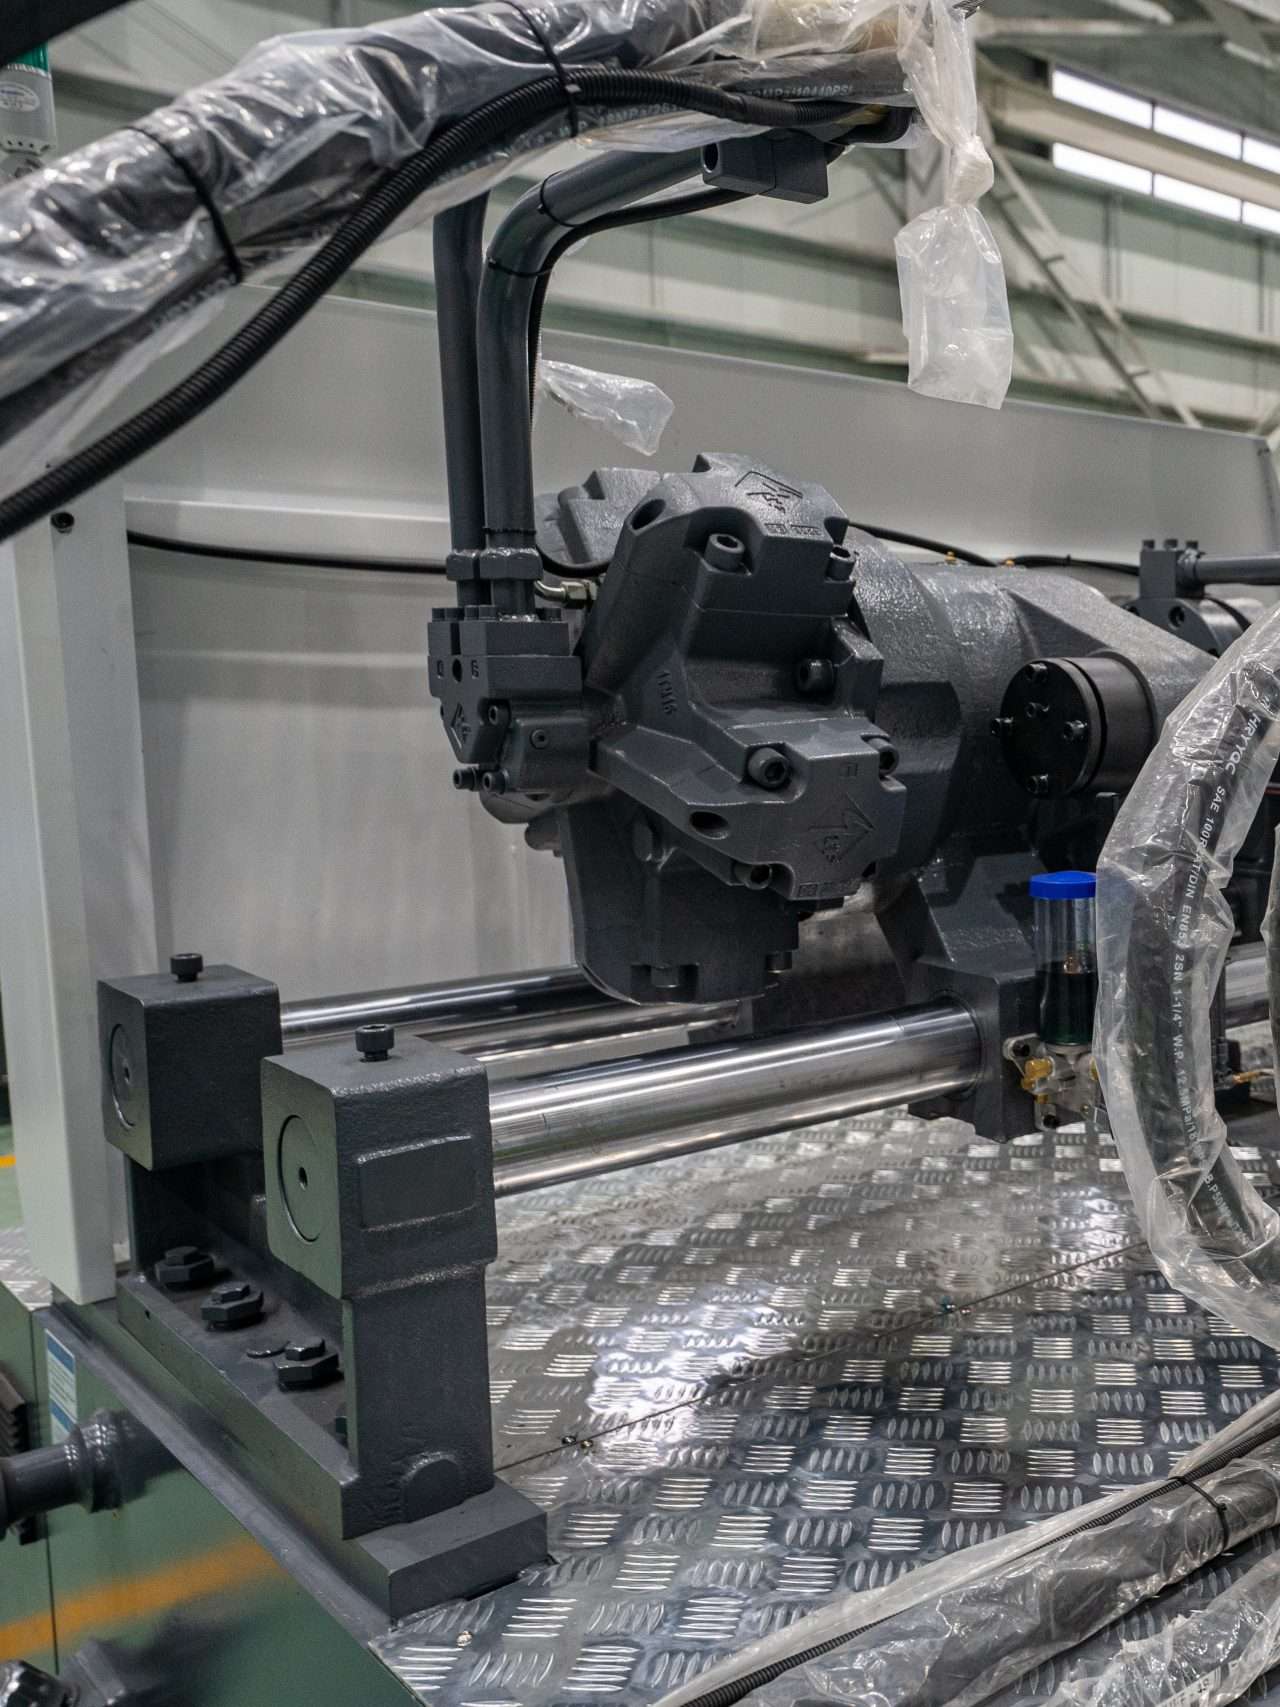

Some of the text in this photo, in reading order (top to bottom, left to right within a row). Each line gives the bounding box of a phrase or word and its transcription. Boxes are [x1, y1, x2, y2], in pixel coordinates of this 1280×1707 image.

[1225, 712, 1261, 775] HRYYQC
[1210, 786, 1226, 813] SAE
[1173, 953, 1184, 981] 2SN
